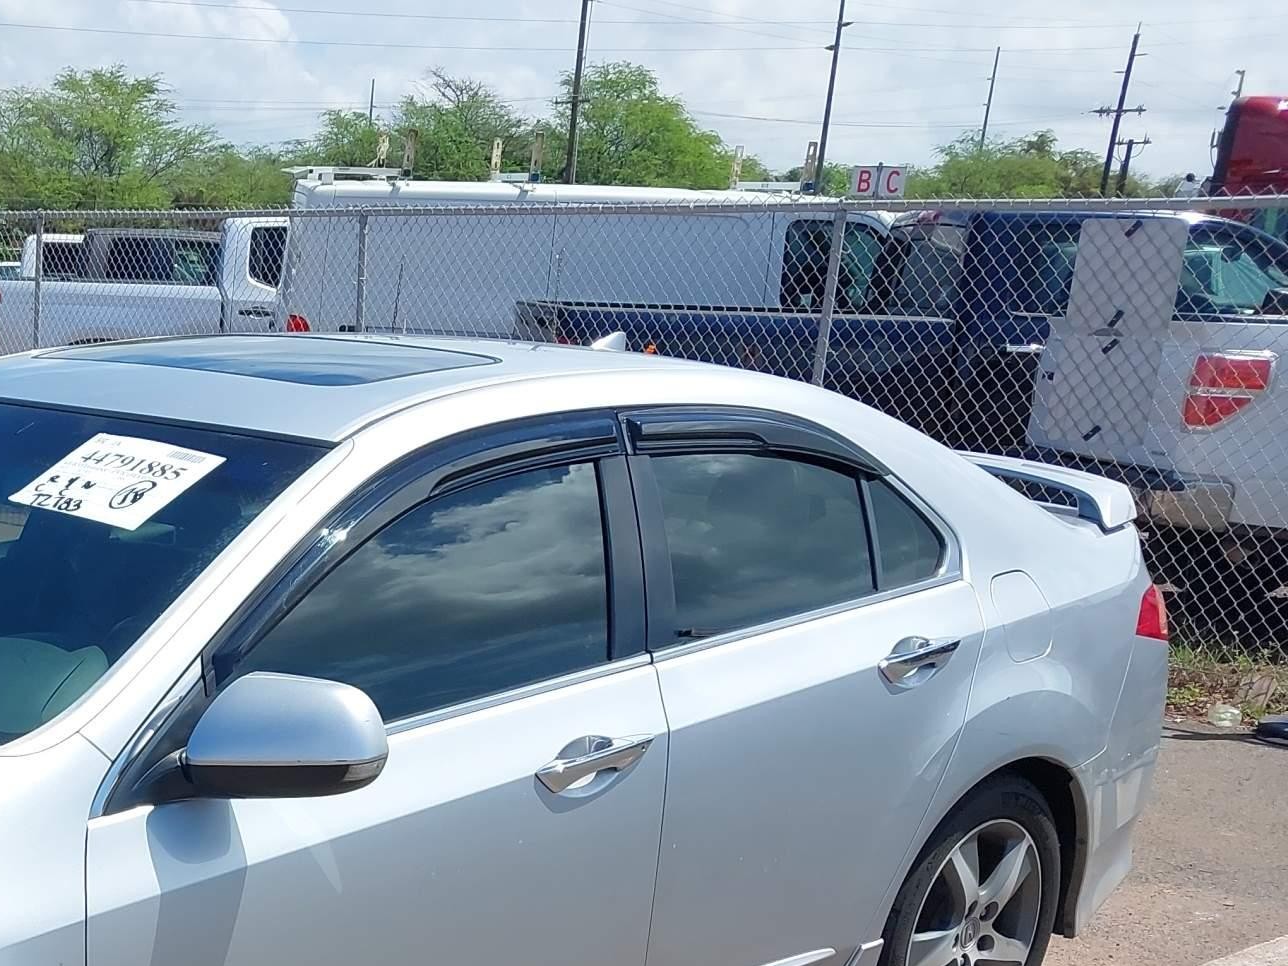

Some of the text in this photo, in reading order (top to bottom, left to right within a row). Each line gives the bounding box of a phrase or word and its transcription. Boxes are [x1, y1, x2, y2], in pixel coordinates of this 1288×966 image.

[857, 170, 900, 193] B C
[81, 450, 188, 480] 44791885
